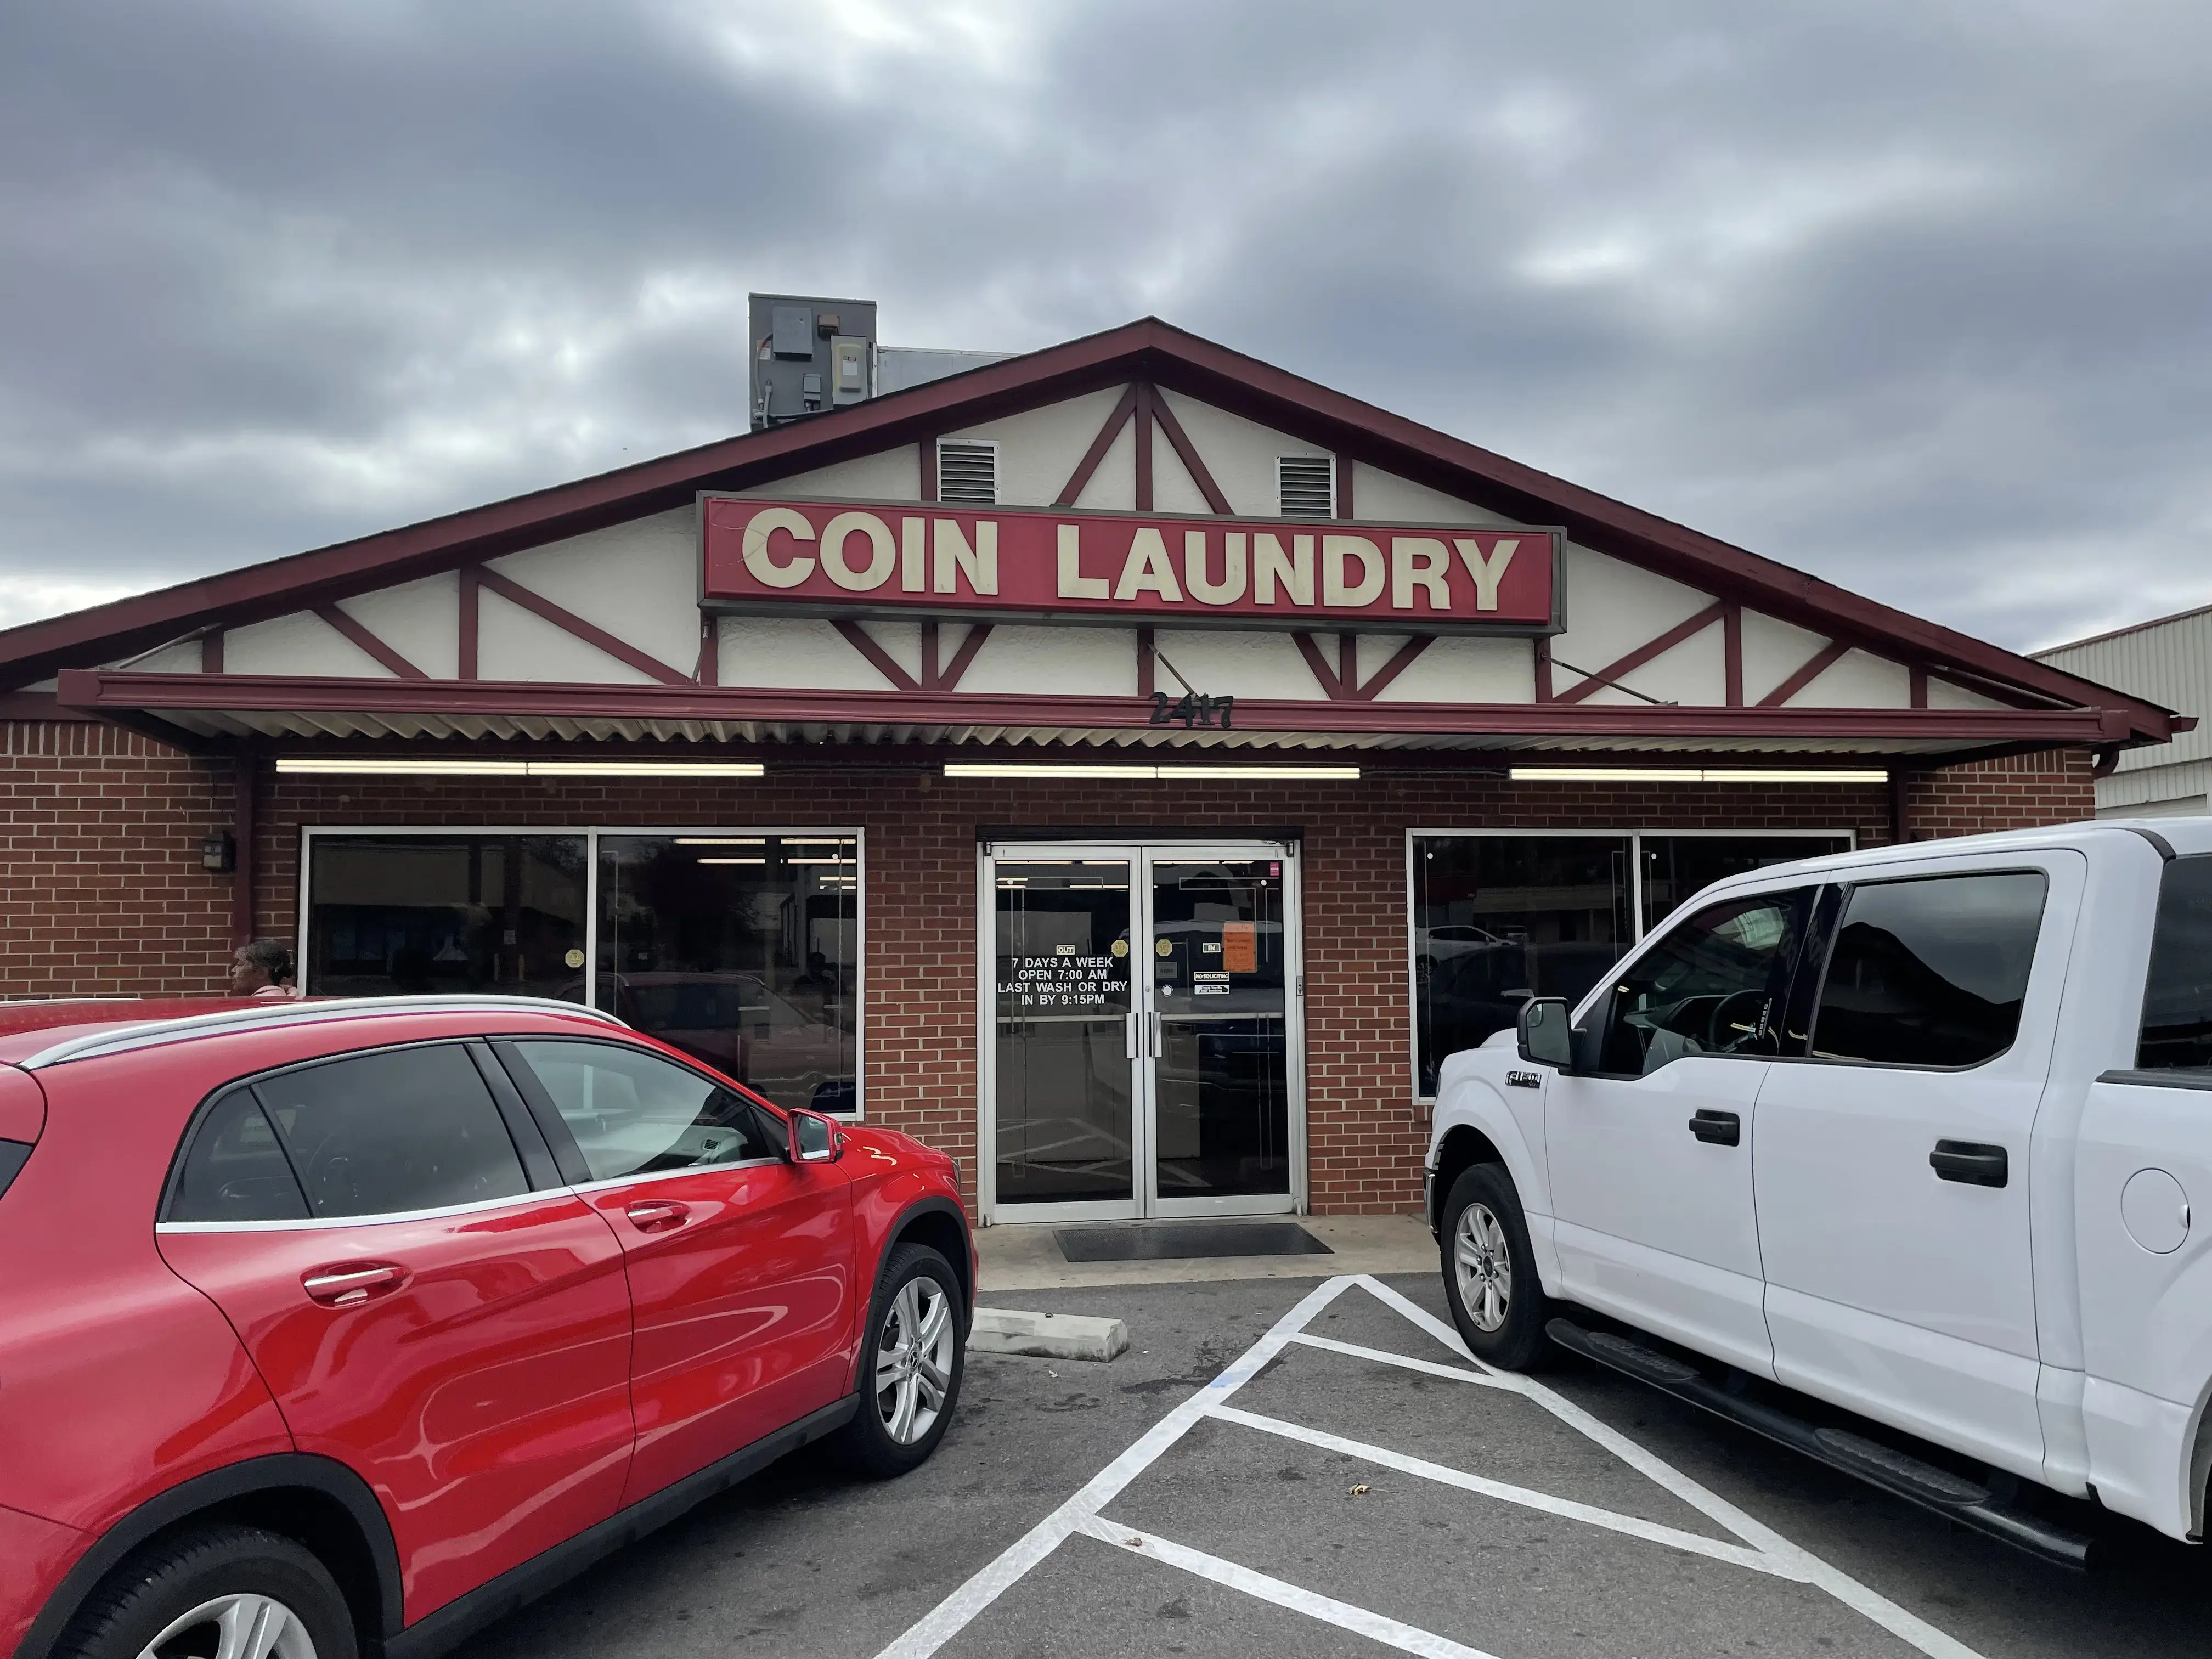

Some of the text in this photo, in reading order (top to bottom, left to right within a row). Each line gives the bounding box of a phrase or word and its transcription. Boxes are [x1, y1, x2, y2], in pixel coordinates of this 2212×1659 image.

[742, 507, 1520, 611] COIN LAUNDRY
[1148, 692, 1233, 729] 2417
[1012, 957, 1113, 968] 7 DAYS A WEEK
[1018, 969, 1107, 980] OPEN 7:00 AM
[998, 981, 1127, 993] LAST WASH OR DRY
[1021, 994, 1104, 1005] IN BY 9:15PM
